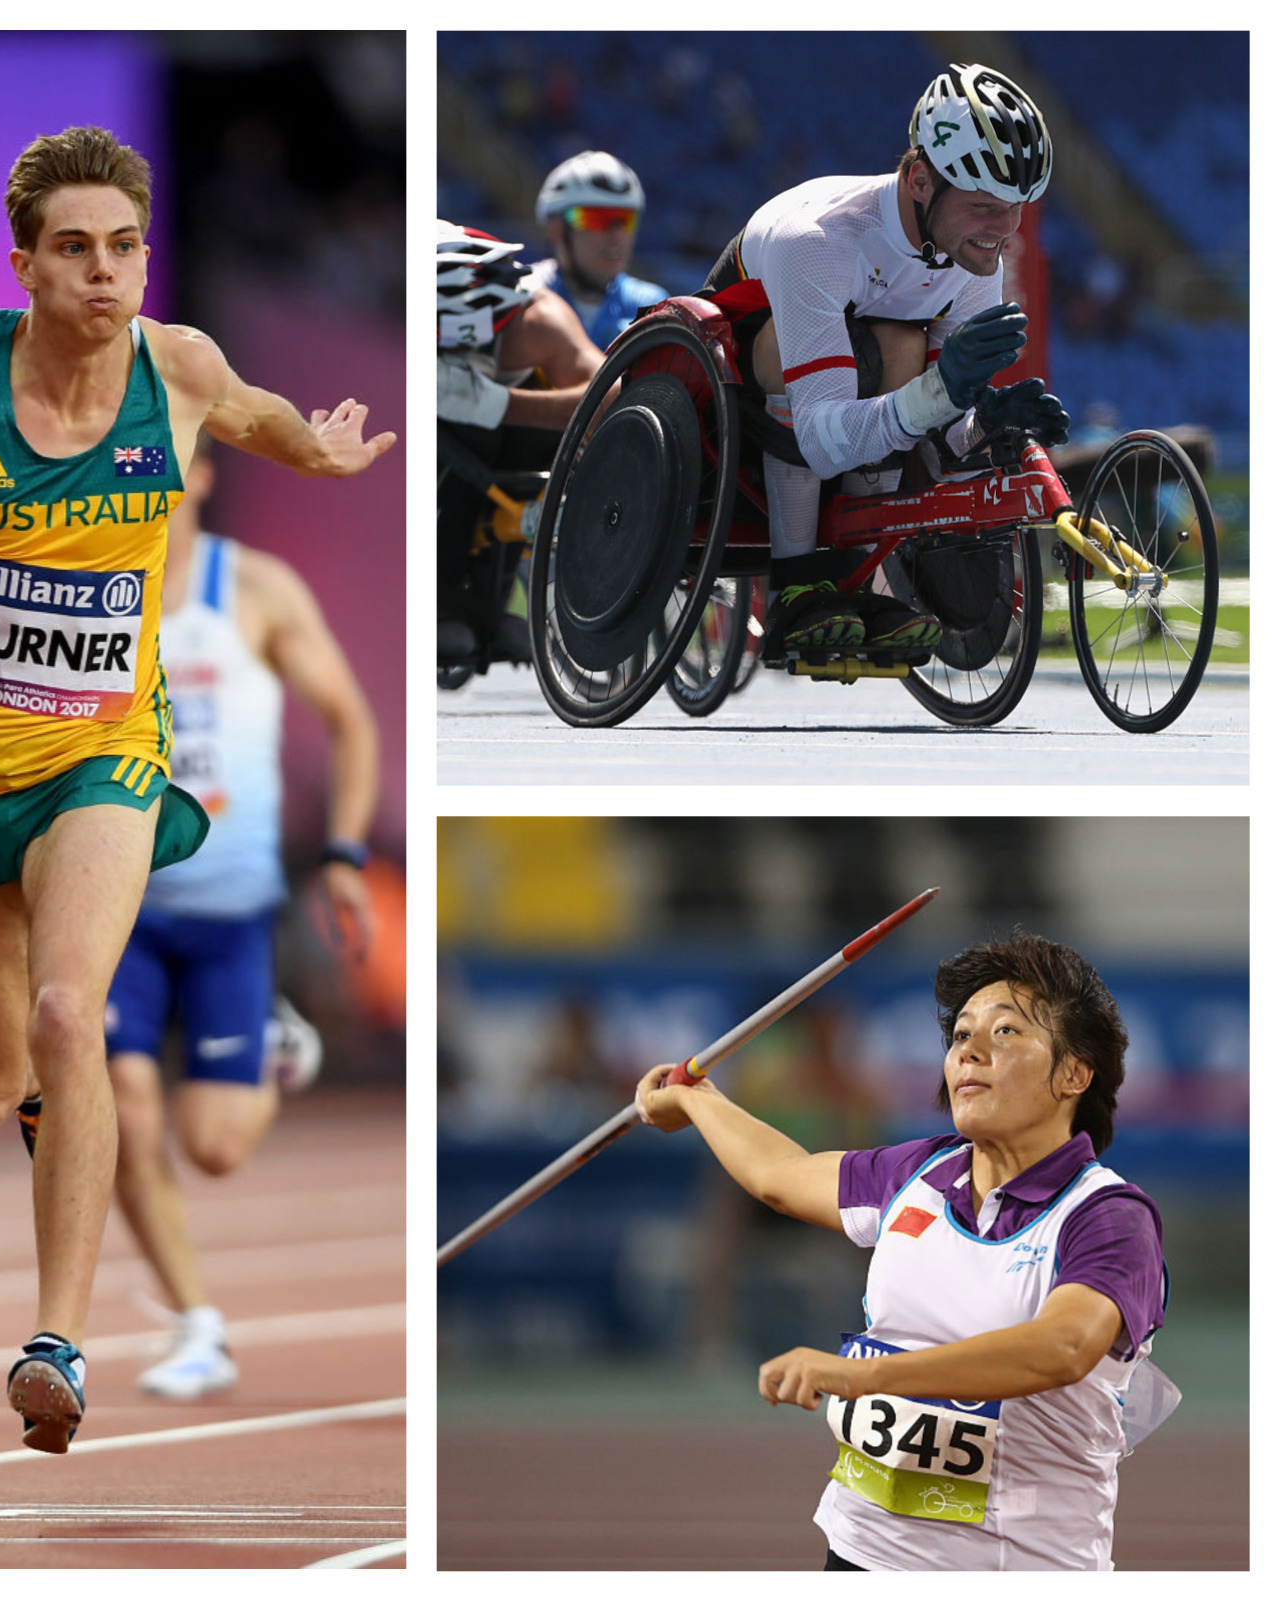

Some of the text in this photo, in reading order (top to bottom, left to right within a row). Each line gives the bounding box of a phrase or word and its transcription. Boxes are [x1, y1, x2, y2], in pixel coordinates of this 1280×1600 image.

[932, 121, 960, 148] 4
[24, 686, 56, 698] Athletics
[60, 702, 99, 717] 2017
[838, 1397, 987, 1476] 1345
